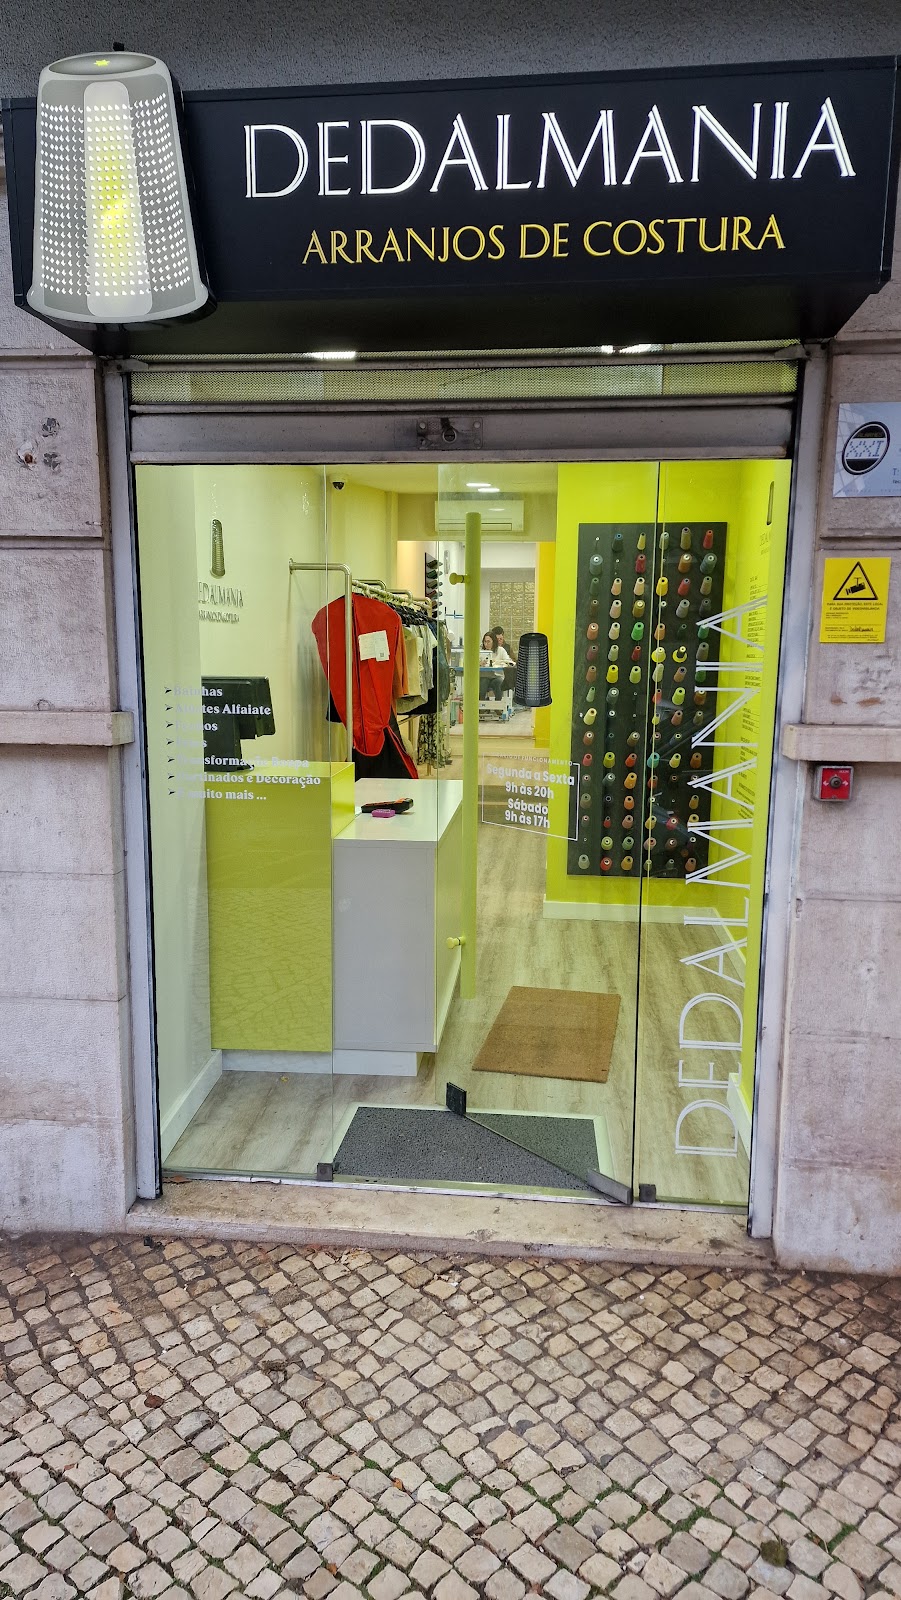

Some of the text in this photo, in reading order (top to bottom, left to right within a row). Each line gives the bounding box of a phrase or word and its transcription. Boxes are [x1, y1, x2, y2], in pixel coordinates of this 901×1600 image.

[244, 97, 857, 198] DEDALMANIA
[302, 213, 786, 264] ARRANJOS DE COSTURA
[222, 703, 272, 716] Alfaiate
[246, 775, 253, 783] e
[256, 773, 321, 788] Decoração
[486, 764, 575, 786] Segunda a Sexta
[225, 789, 254, 800] mais
[505, 781, 554, 800] 9h às 20h
[508, 798, 548, 815] Sábado
[505, 810, 551, 829] 9h às 17h
[675, 593, 769, 1158] DEDALMANIA
